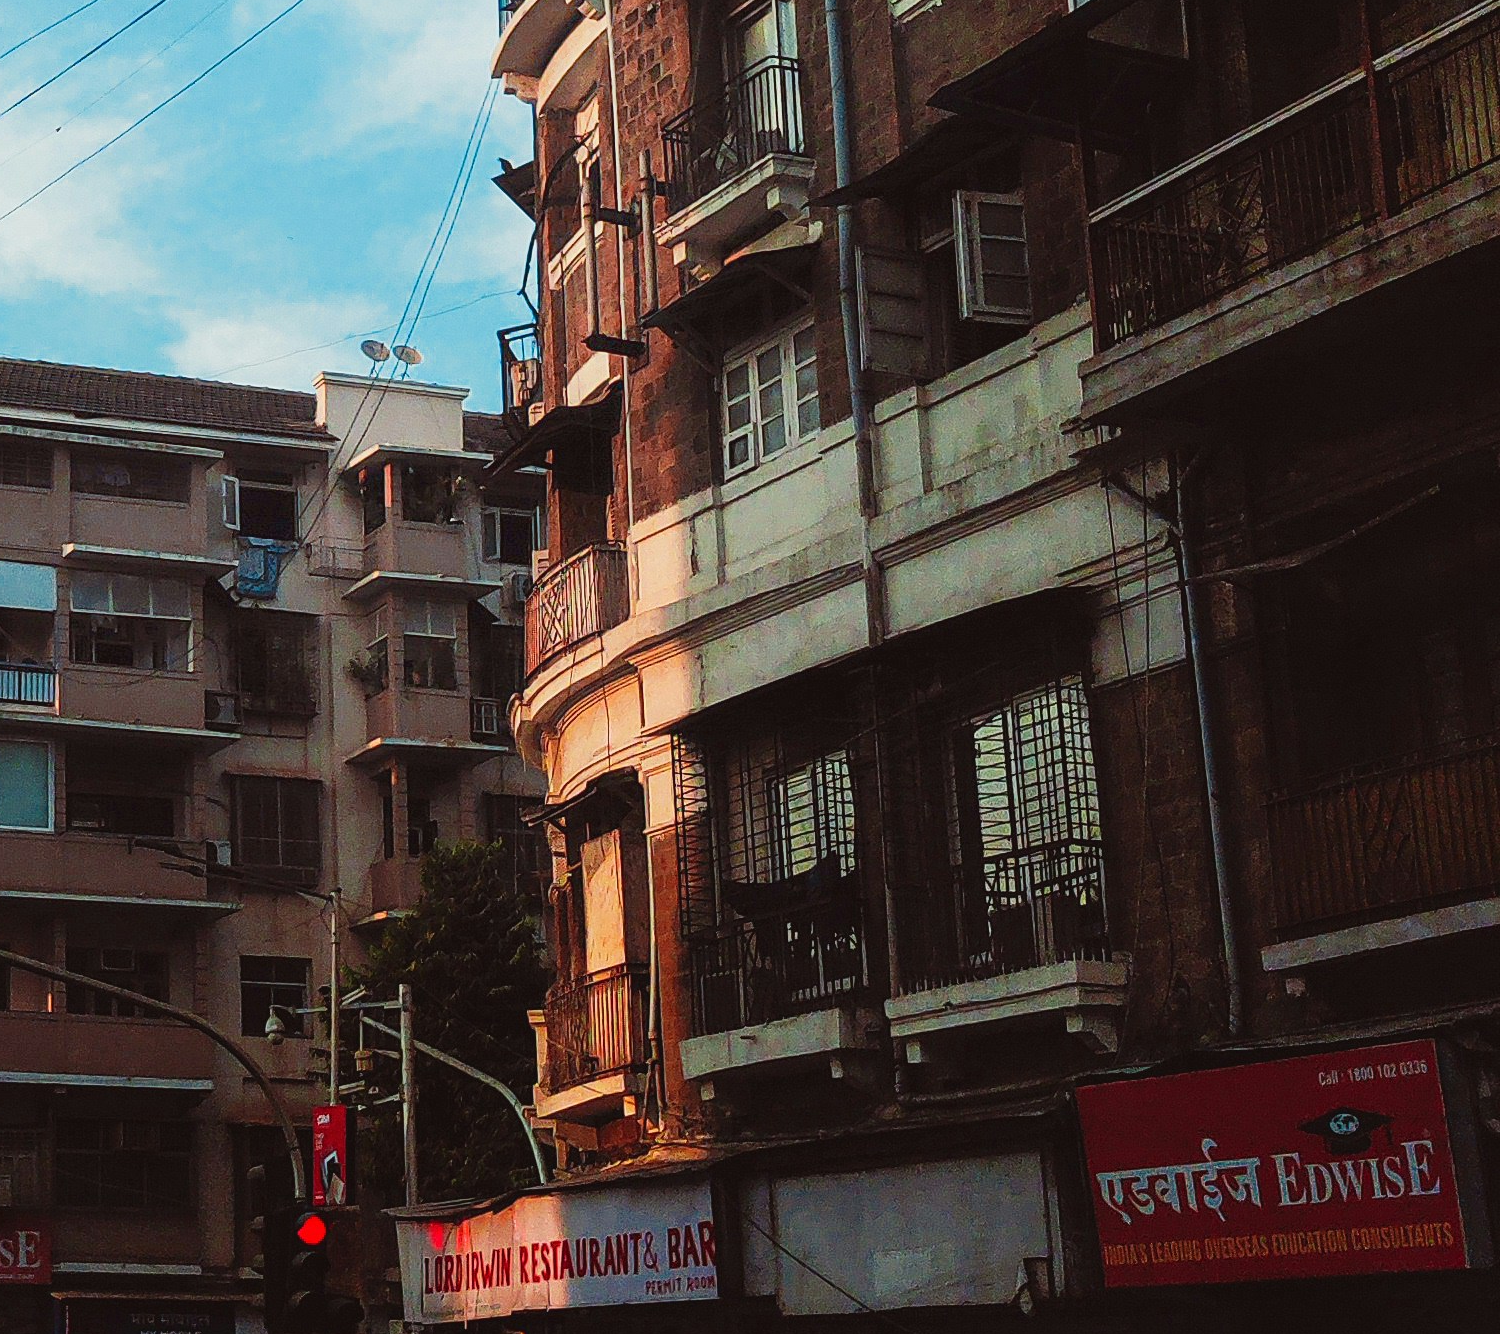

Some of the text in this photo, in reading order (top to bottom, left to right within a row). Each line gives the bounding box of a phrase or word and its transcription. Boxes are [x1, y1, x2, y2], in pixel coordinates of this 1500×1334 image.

[1318, 1069, 1338, 1087] Call
[1347, 1065, 1374, 1083] 1800
[1377, 1062, 1397, 1079] 102
[1096, 1138, 1261, 1225] एडवाईज
[424, 1221, 717, 1295] LORD IRWIN RESTAURANT & BAR
[1150, 1239, 1203, 1264] LEADING
[1204, 1235, 1270, 1261] OVERSEAS
[1271, 1230, 1348, 1257] EDUCATION
[1351, 1222, 1455, 1251] CONSULTANTS
[645, 1274, 716, 1296] PERMIT ROOM
